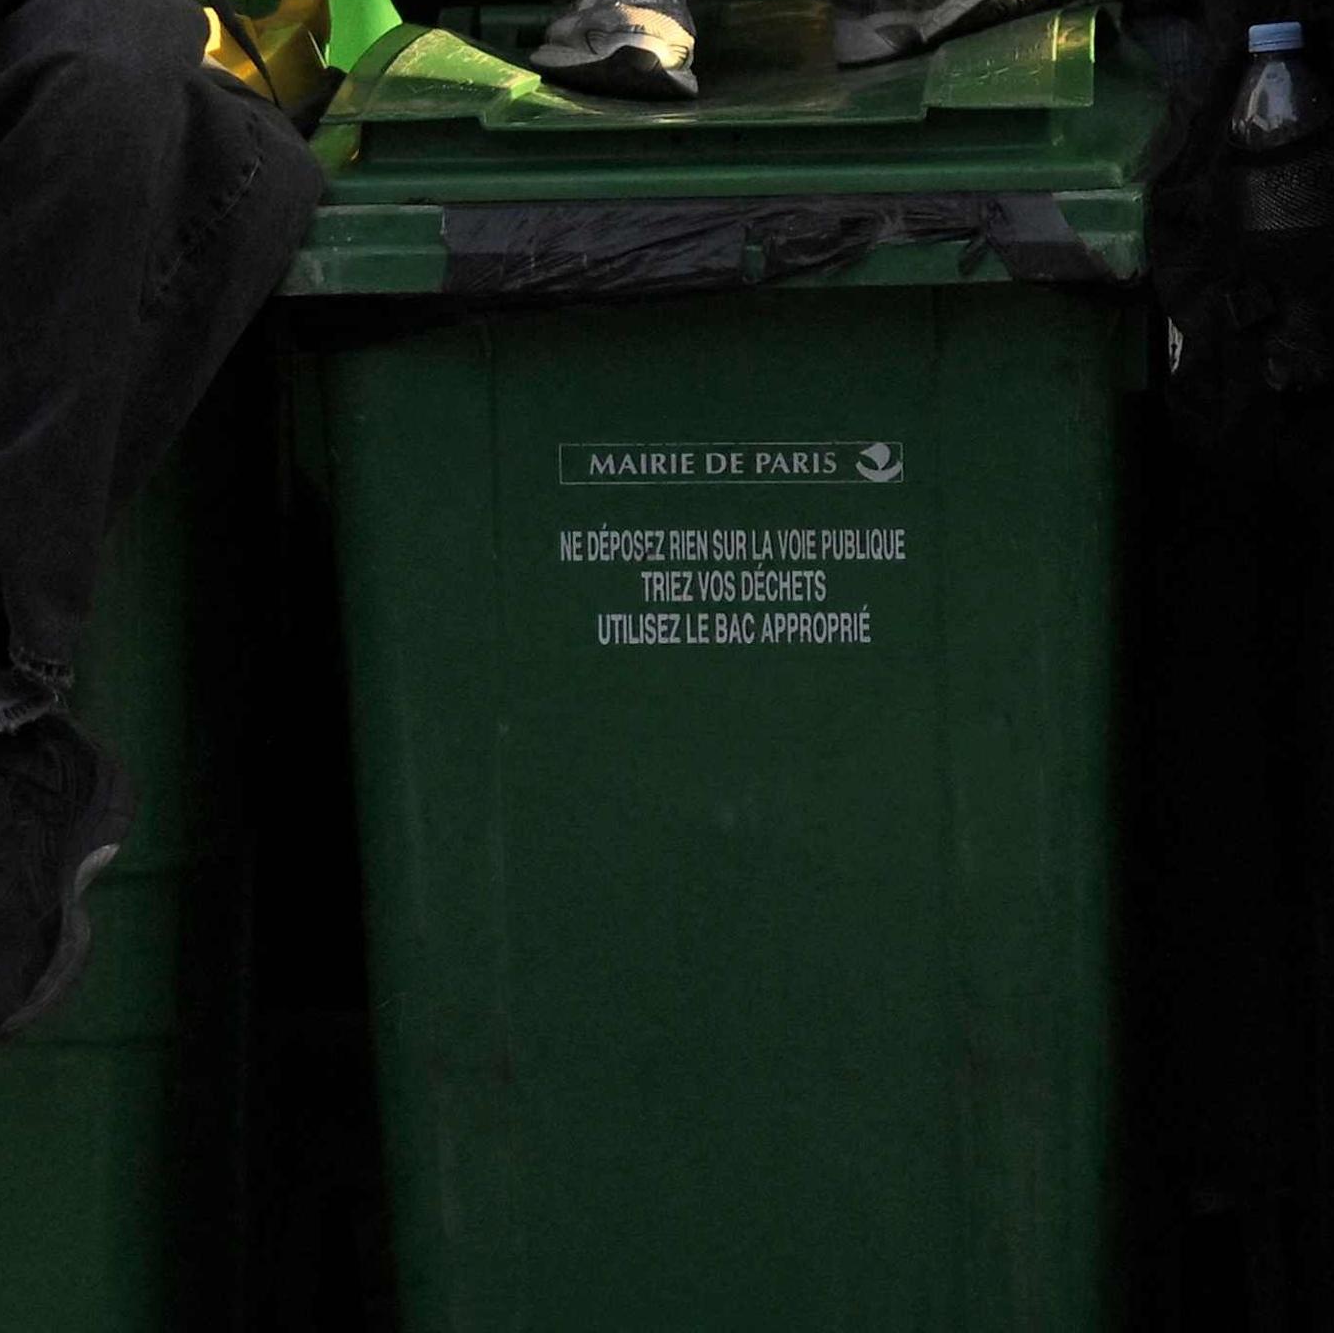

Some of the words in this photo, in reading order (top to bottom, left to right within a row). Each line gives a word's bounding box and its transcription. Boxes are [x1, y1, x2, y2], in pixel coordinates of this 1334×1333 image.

[589, 452, 696, 475] MAIRIE
[705, 452, 744, 475] DE
[755, 451, 838, 474] PARIS
[560, 530, 583, 562] NE
[587, 522, 666, 562] DÉPOSEZ
[670, 530, 709, 561] RIEN
[713, 530, 747, 561] SUR
[752, 529, 774, 560] LA
[777, 529, 817, 560] VOIE
[821, 528, 906, 561] PUBLIQUE
[640, 570, 694, 603] TRIEZ
[698, 570, 736, 602] VOS
[741, 563, 827, 602] DÉCHETS
[597, 613, 681, 645] UTILISEZ
[685, 613, 710, 644] LE
[715, 612, 755, 644] BAC
[761, 604, 872, 644] APPROPRIÉ
